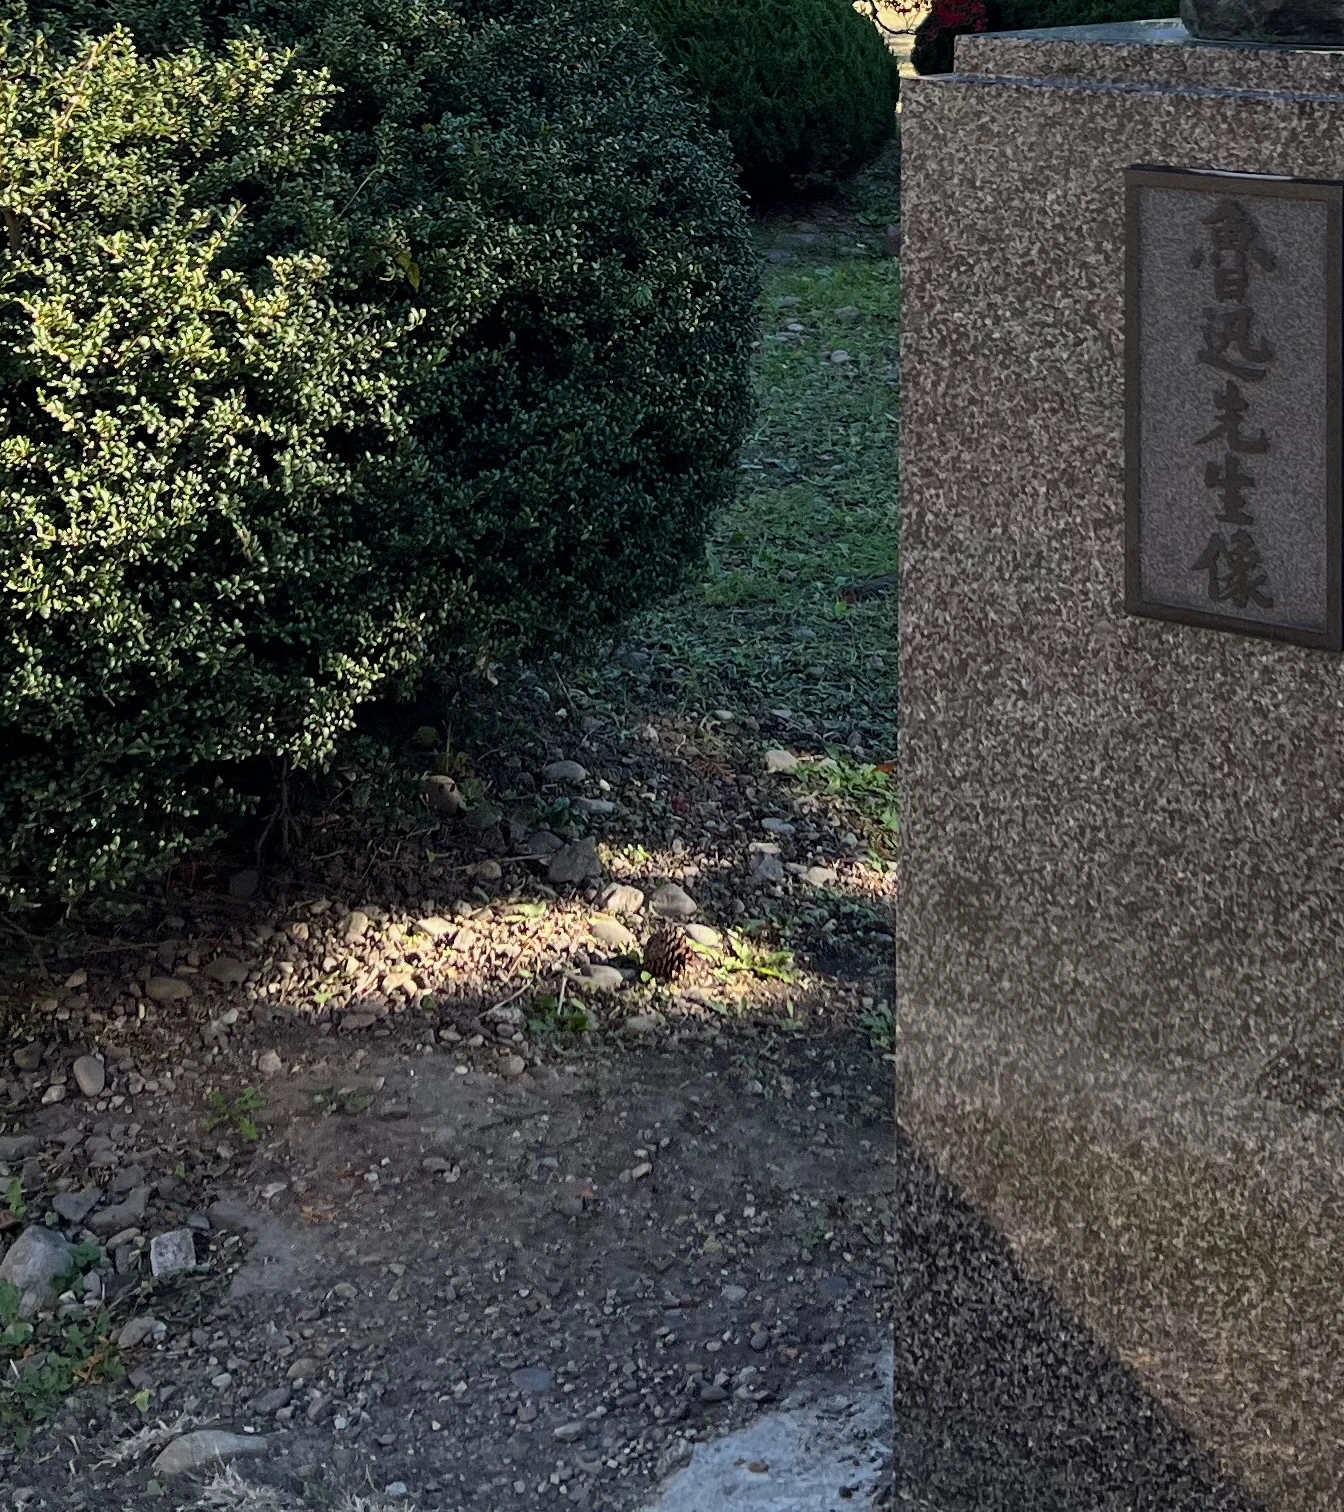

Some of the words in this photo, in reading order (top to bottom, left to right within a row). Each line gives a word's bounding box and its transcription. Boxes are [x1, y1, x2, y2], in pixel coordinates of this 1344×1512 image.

[1189, 198, 1277, 609] 魯迅先生像
